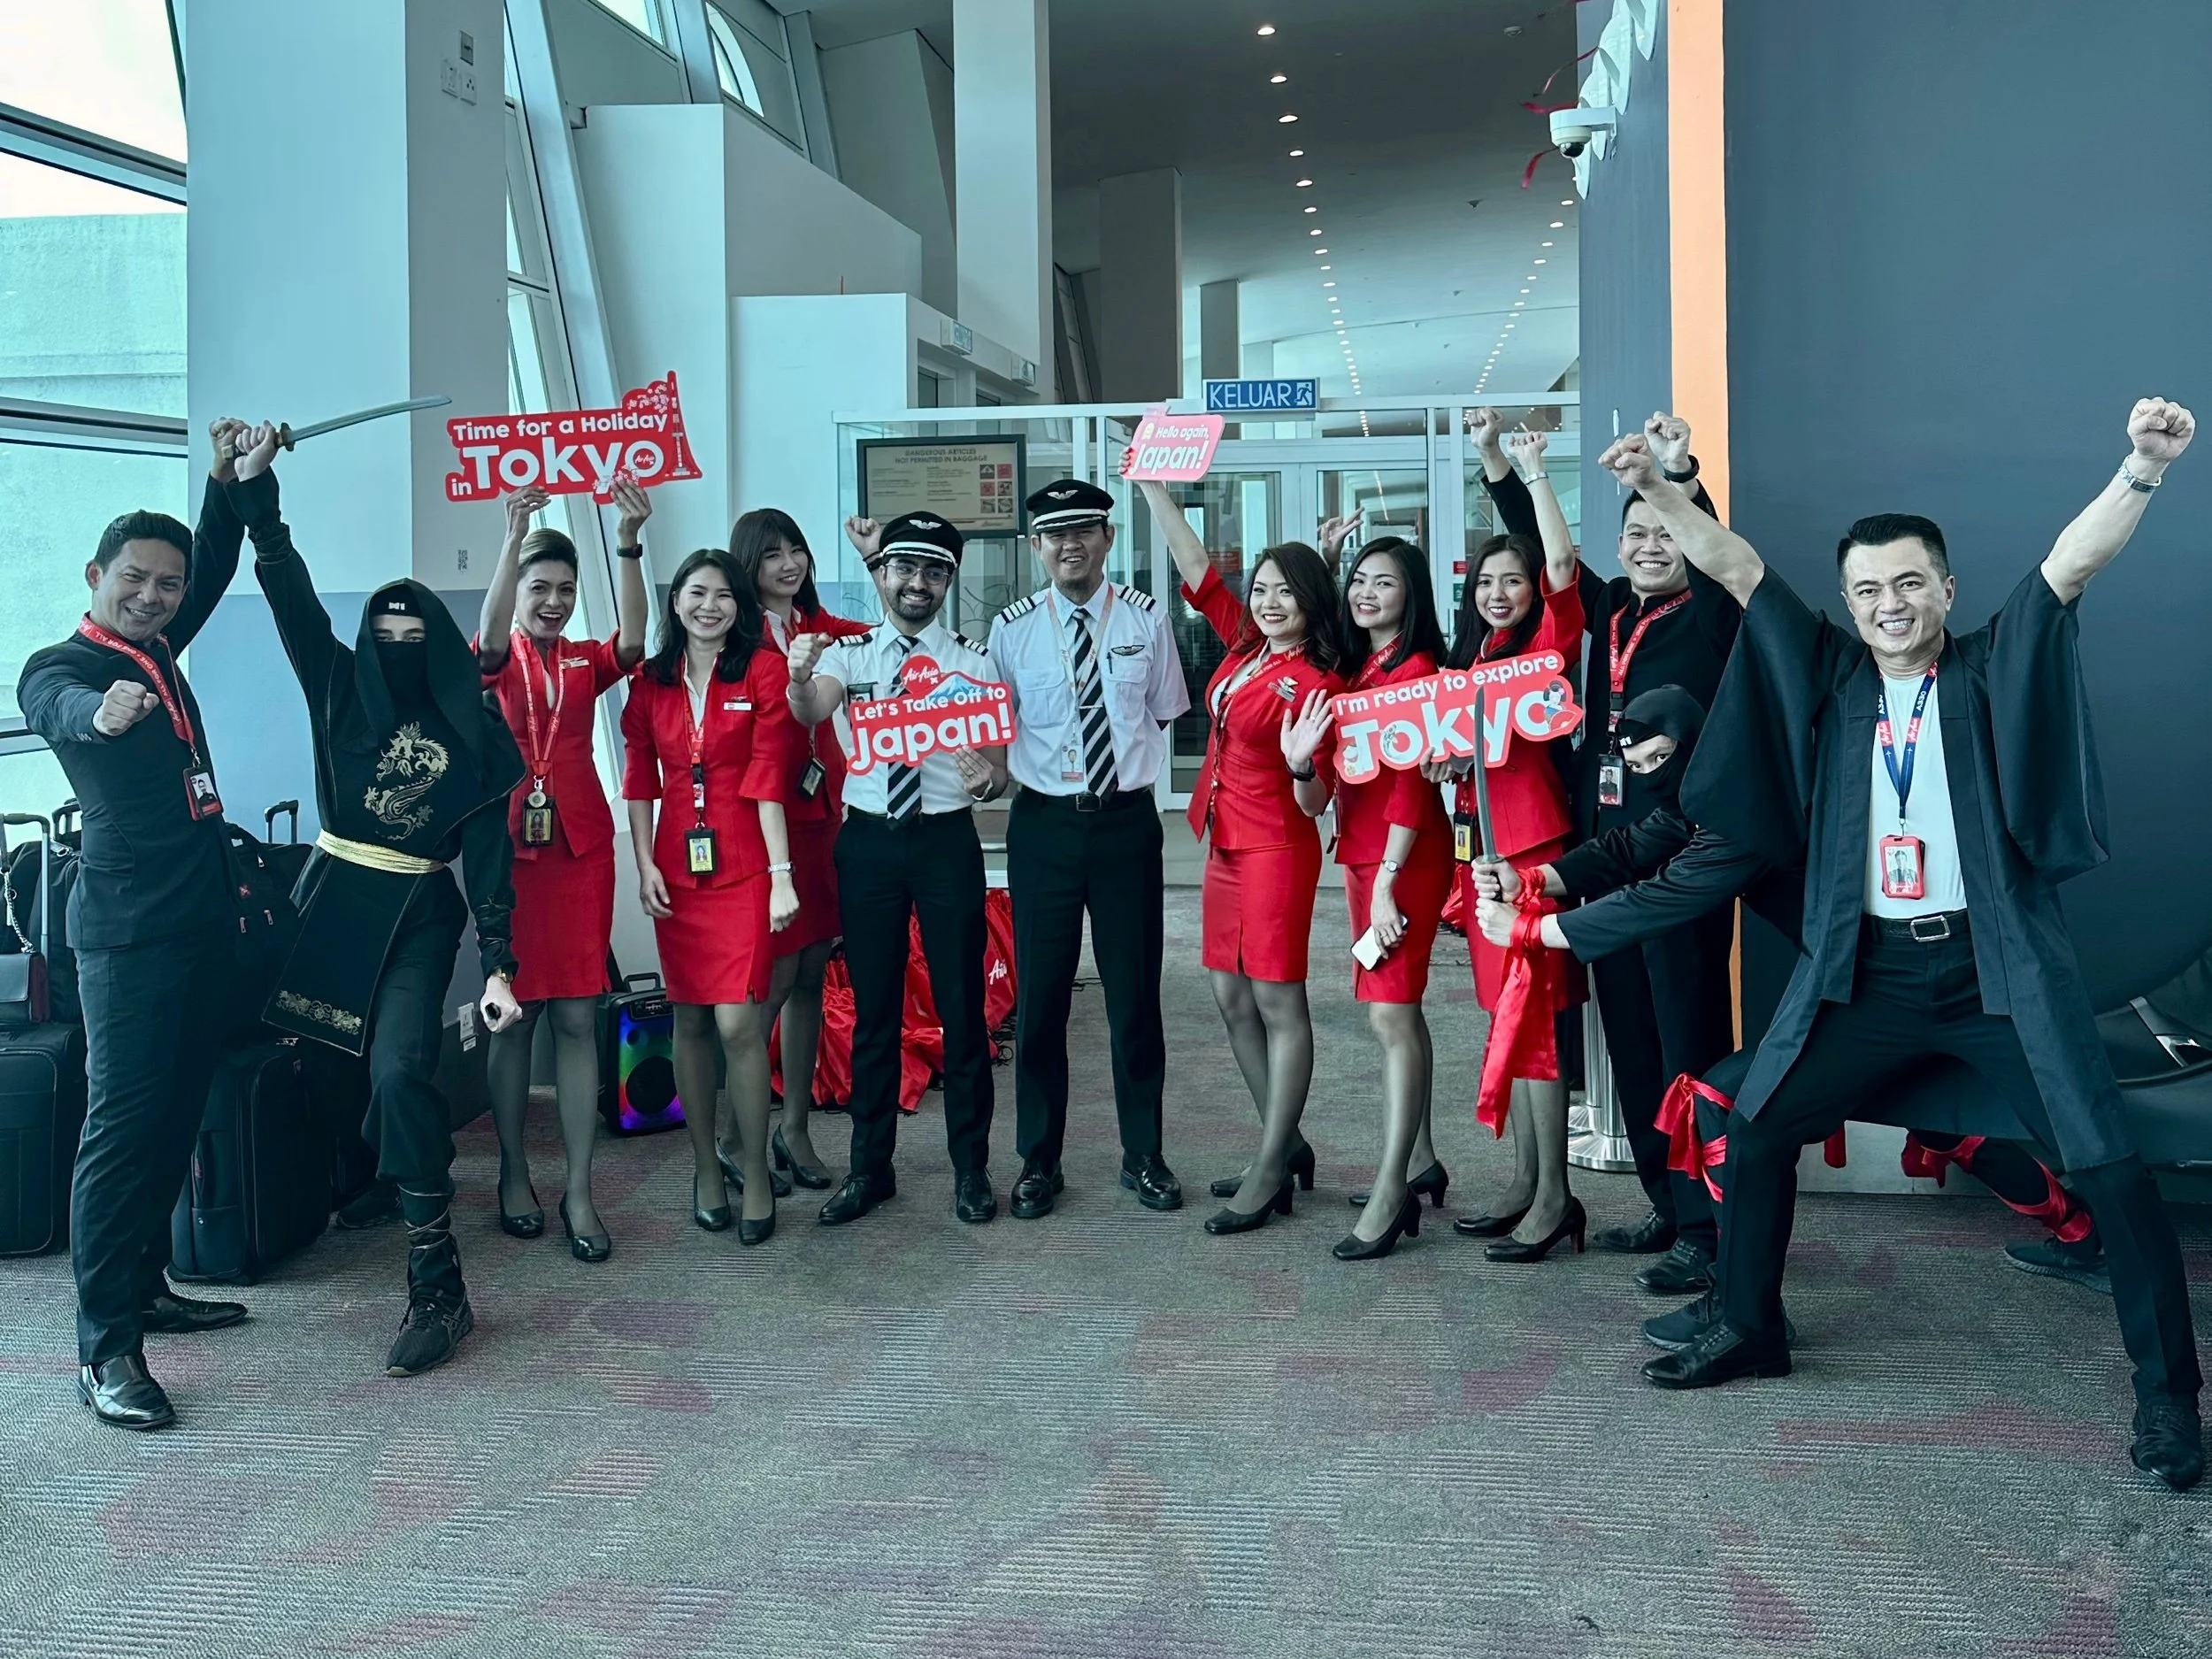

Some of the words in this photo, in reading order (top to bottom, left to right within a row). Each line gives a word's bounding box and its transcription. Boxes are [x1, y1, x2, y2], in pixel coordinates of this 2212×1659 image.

[1210, 382, 1292, 409] KELUAR
[453, 421, 510, 441] Time
[517, 419, 552, 437] for
[558, 419, 574, 434] a
[581, 412, 667, 433] Holiday
[1156, 426, 1179, 438] Hello
[1179, 425, 1210, 442] again,
[451, 479, 472, 496] in
[462, 436, 664, 495] Tokyo
[1130, 440, 1210, 475] Japan!
[95, 631, 109, 642] ALL
[107, 640, 124, 649] FOR
[139, 657, 154, 670] ONE
[903, 665, 940, 686] AirAsia
[151, 669, 163, 684] FOR
[1335, 696, 1371, 716] I'm
[1373, 680, 1439, 706] ready
[1443, 673, 1467, 693] to
[1471, 654, 1559, 686] explore
[854, 701, 898, 721] Let's
[902, 694, 949, 713] Take
[954, 687, 982, 706] Off
[986, 687, 1006, 701] to
[1916, 690, 1927, 711] A330
[850, 703, 1012, 771] Japan!
